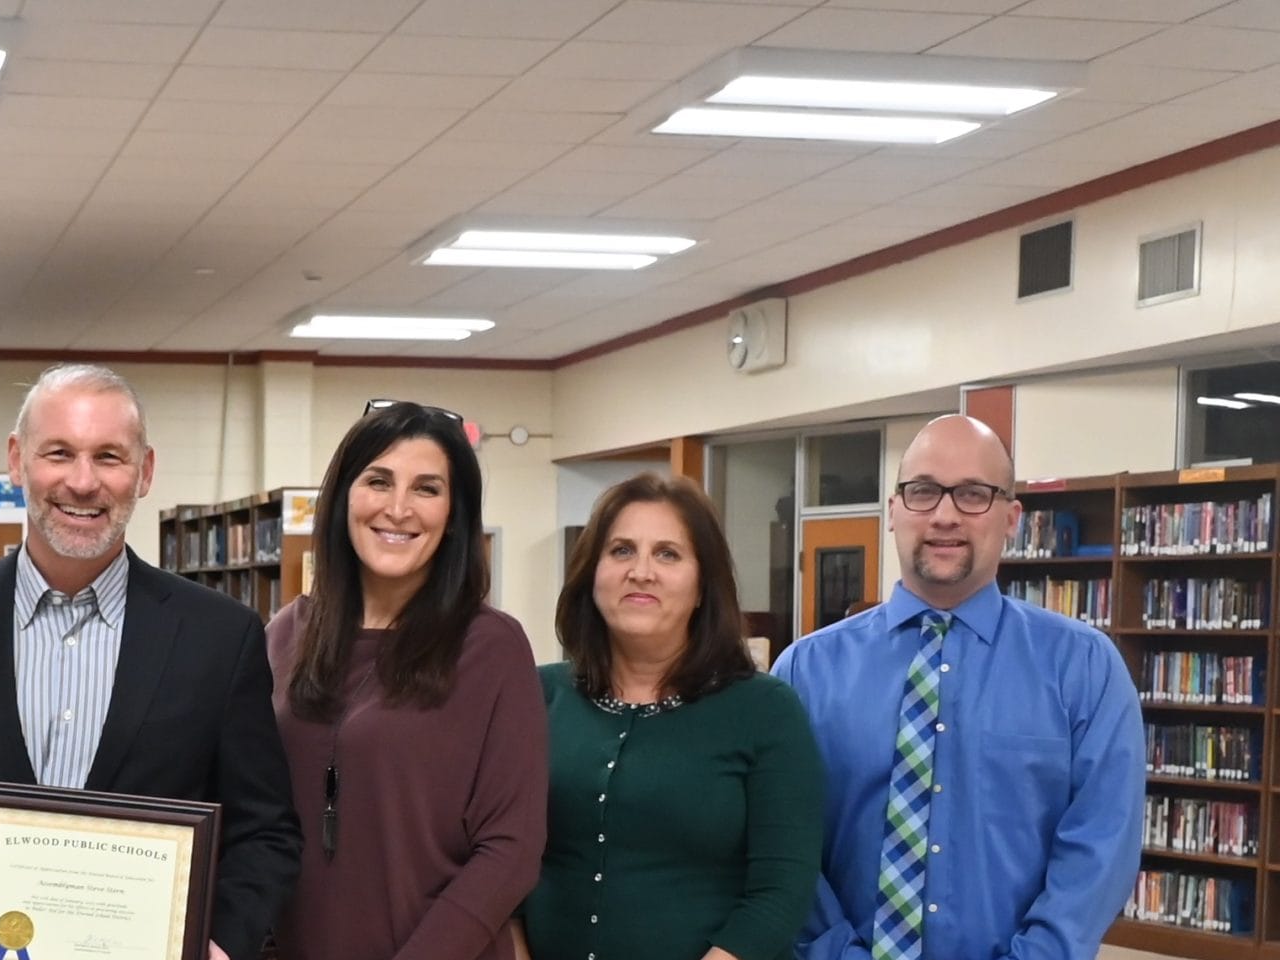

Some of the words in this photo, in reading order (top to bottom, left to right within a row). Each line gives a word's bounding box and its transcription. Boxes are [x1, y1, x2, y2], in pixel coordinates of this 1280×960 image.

[5, 836, 60, 847] ELWOOD
[63, 839, 108, 851] PUBLIC
[111, 843, 168, 862] SCHOOLS
